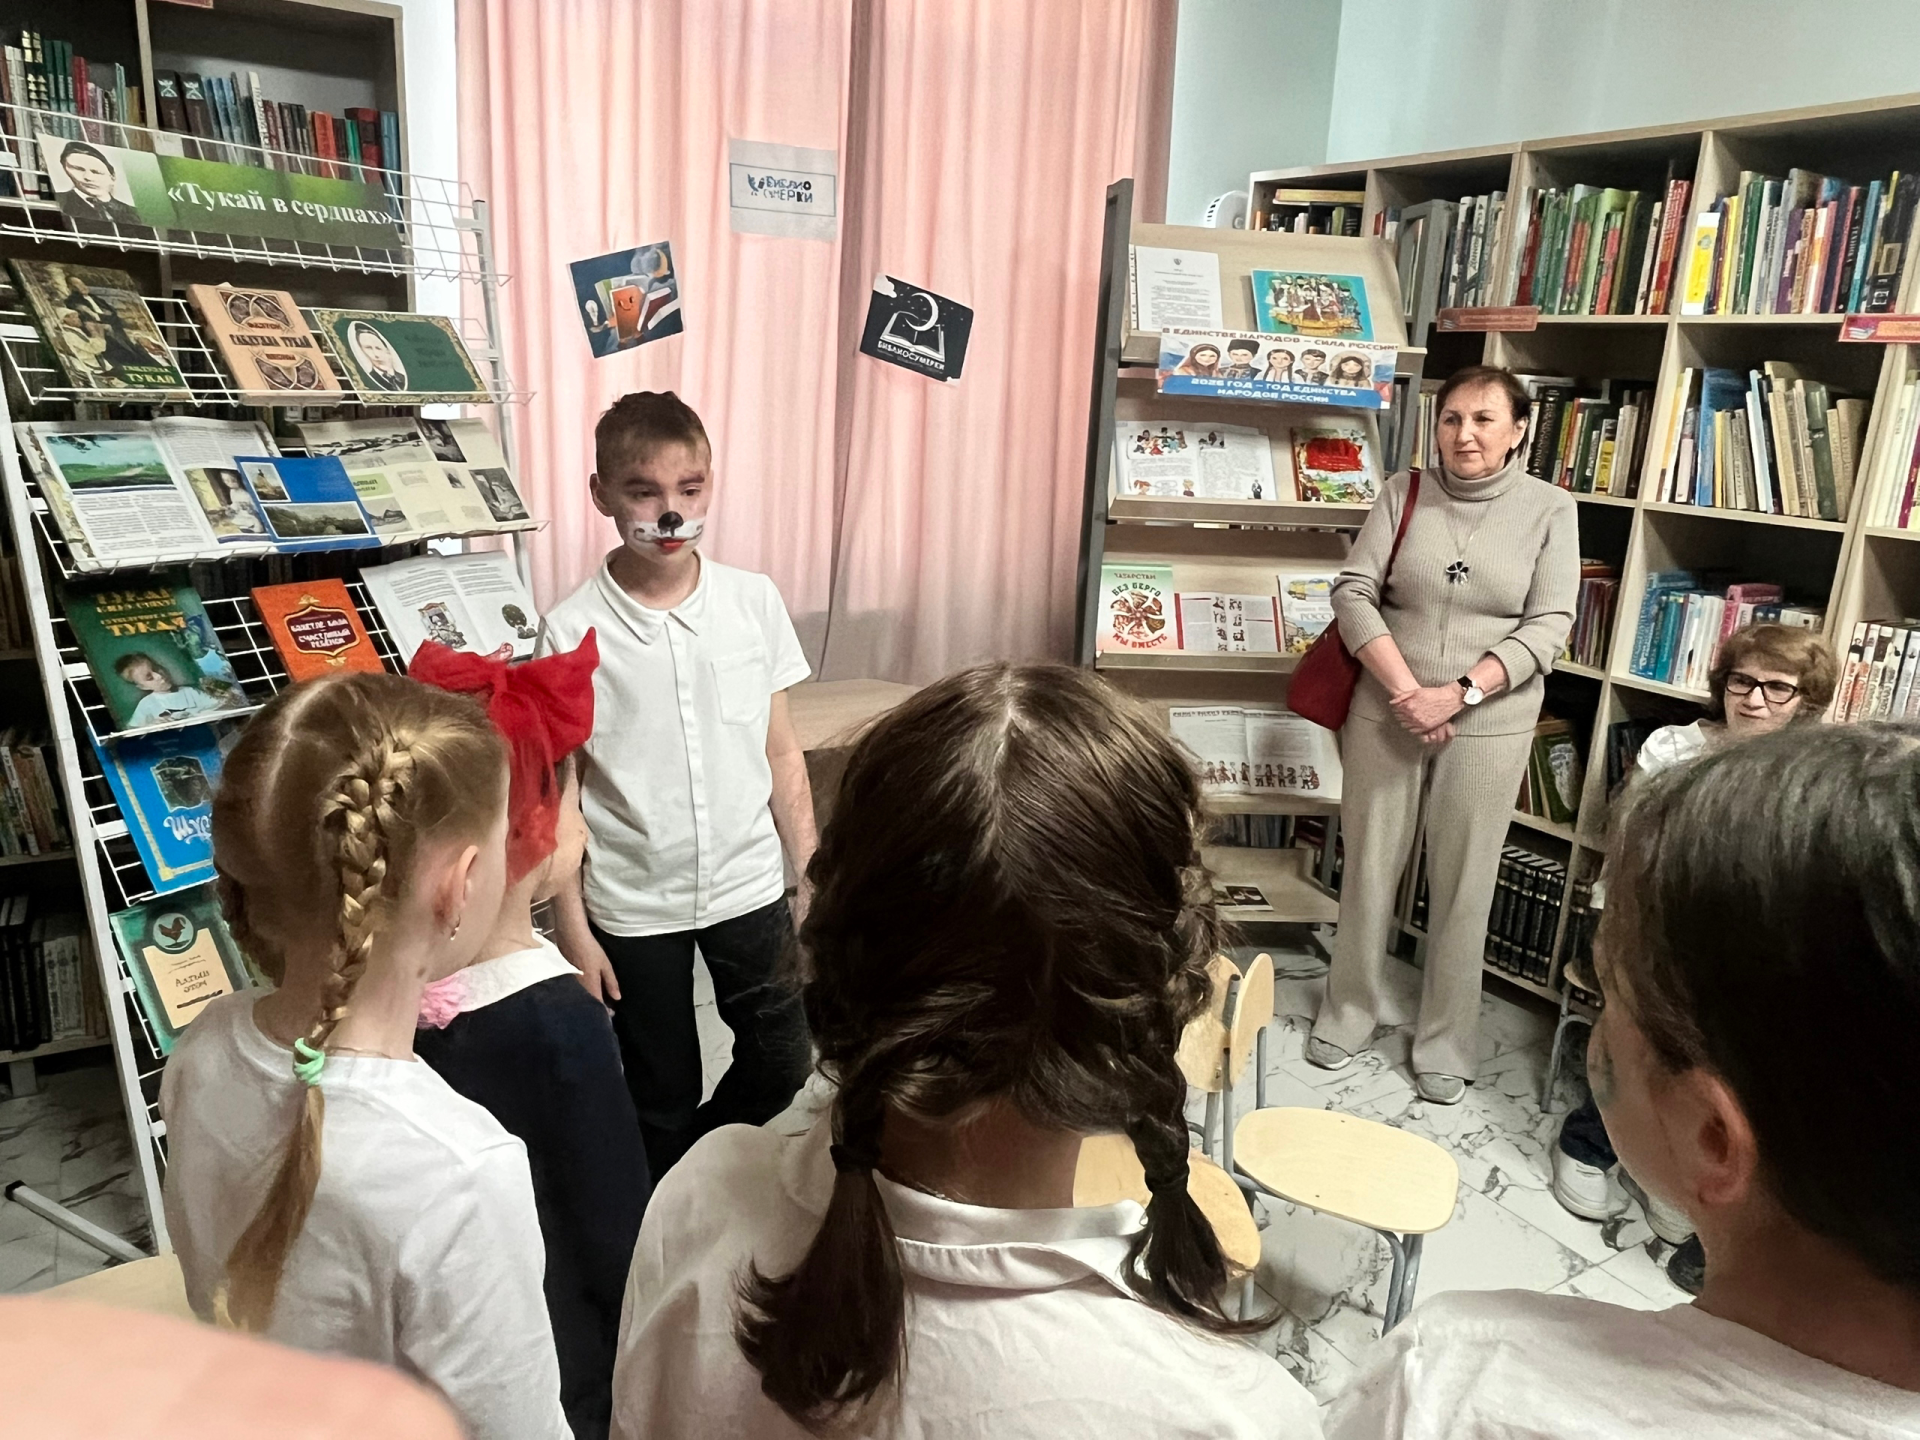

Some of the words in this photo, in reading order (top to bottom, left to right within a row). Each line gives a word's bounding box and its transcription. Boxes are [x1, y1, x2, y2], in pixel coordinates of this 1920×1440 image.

[167, 182, 267, 211] «Тукай
[273, 198, 289, 213] в
[291, 199, 393, 225] сердцах»
[1173, 328, 1237, 339] ЕДИНСТВЕ
[1239, 333, 1301, 343] НАРОДОВ
[1314, 339, 1346, 348] СИЛА
[877, 340, 945, 371] БИБЛИОСУМЕРКИ
[1190, 378, 1225, 386] 2026
[1227, 380, 1253, 389] ГОД
[1266, 383, 1291, 392] ГОД
[1293, 386, 1357, 397] ЕДИНСТВА
[1216, 388, 1279, 399] НАРОДОВ
[1281, 393, 1329, 403] РОССИИ
[1111, 583, 1129, 597] БЕЗ
